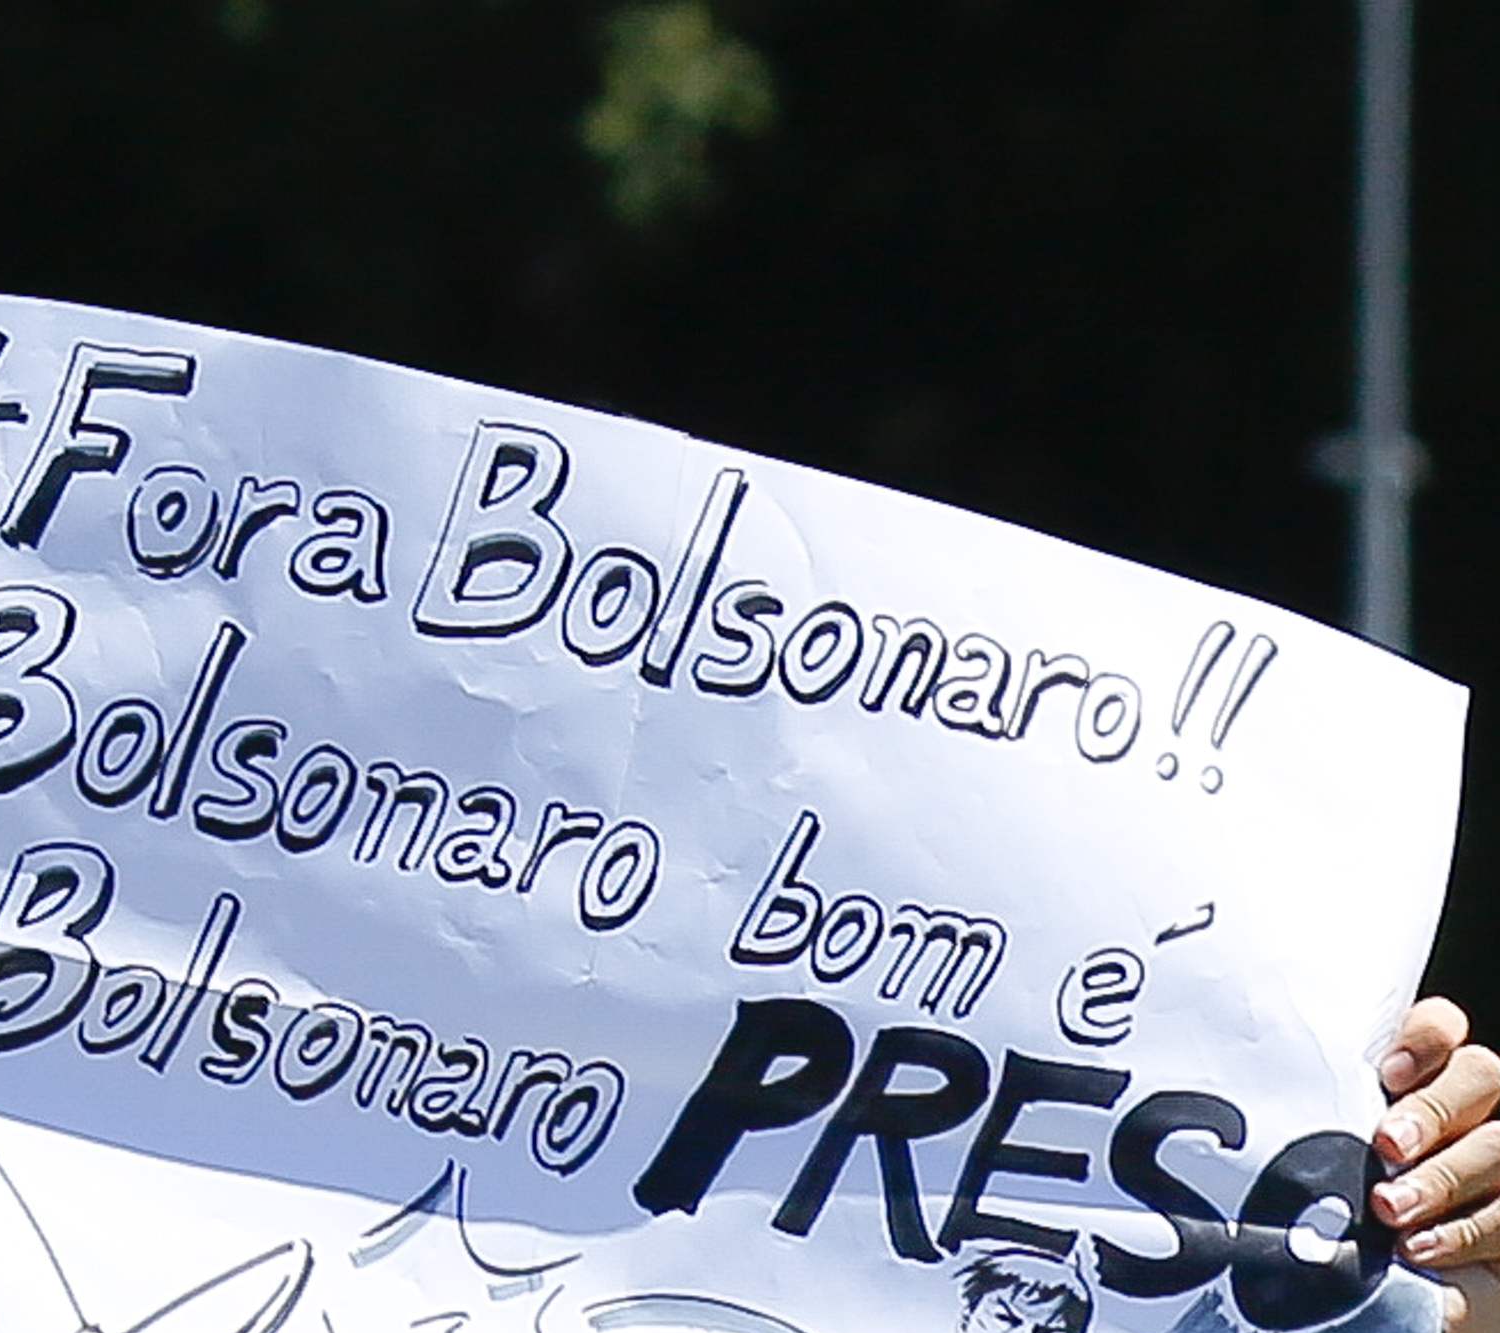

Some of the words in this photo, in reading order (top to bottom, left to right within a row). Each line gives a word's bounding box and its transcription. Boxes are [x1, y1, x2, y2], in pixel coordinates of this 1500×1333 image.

[729, 810, 1007, 1020] bom
[1056, 902, 1215, 1047] é
[633, 997, 1394, 1333] PRESO
